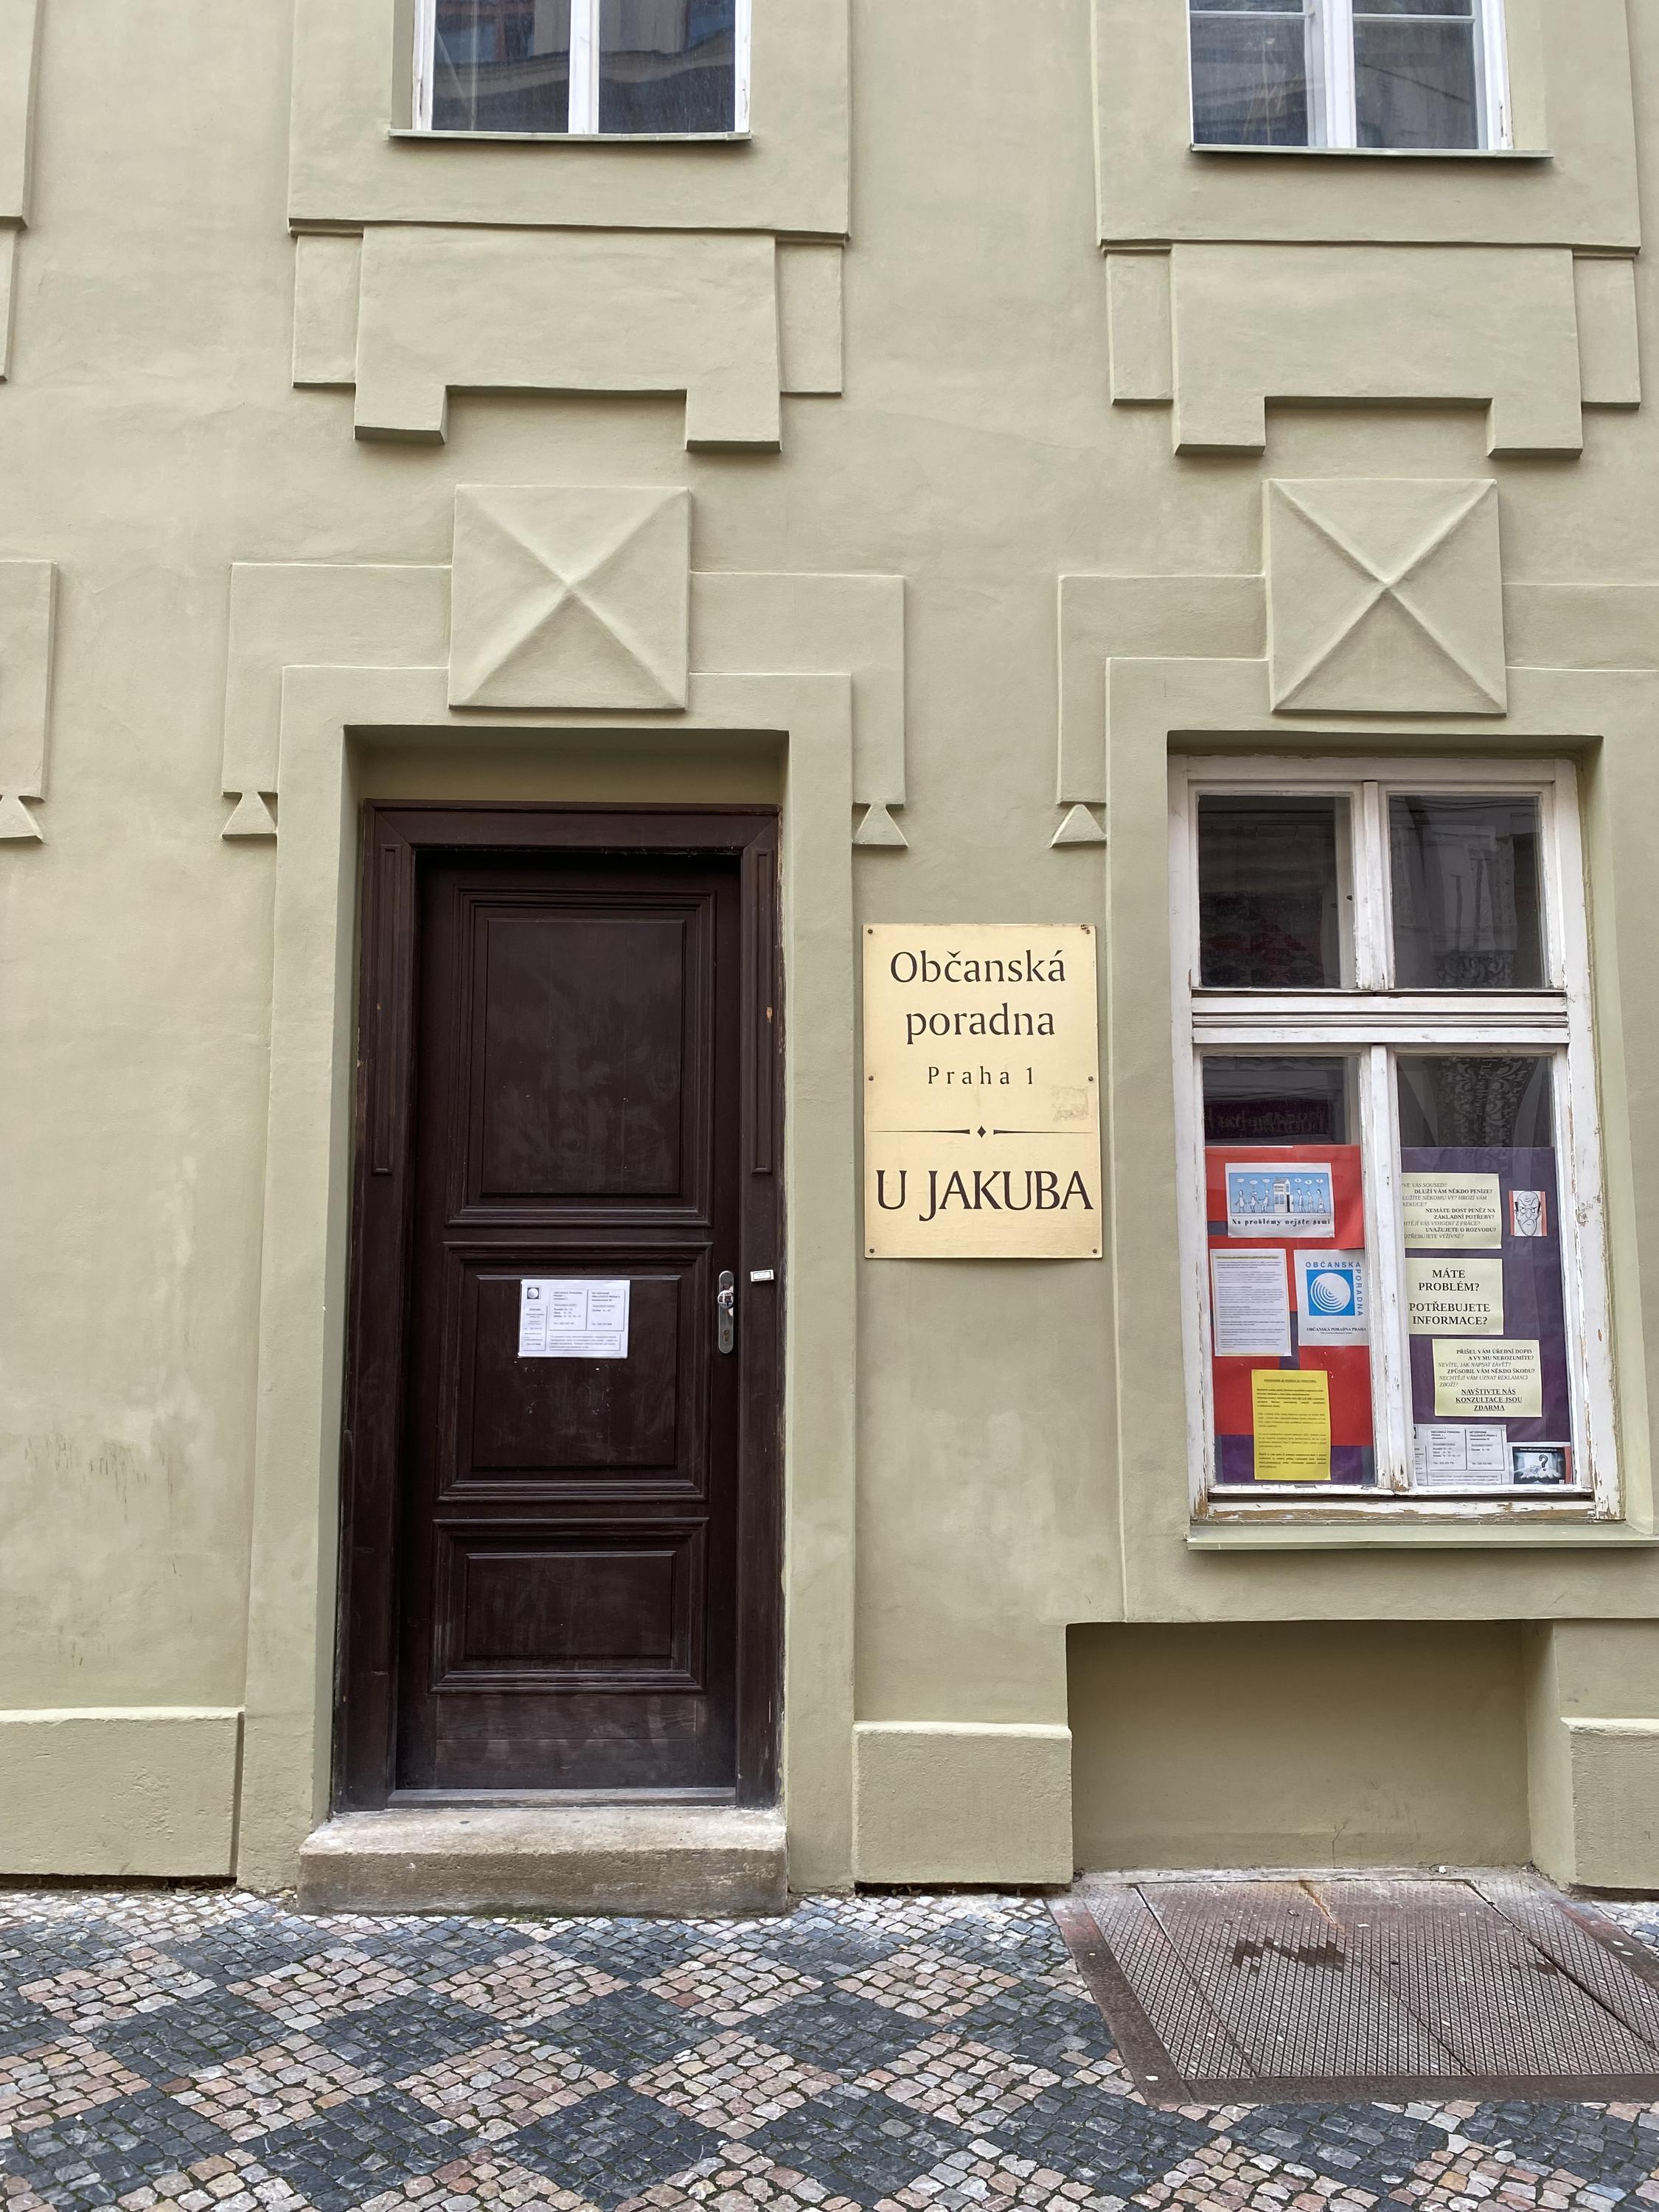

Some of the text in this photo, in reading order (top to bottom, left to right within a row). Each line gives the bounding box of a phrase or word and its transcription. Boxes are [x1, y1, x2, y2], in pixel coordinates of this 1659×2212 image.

[890, 950, 1065, 983] Občanská
[906, 1003, 1055, 1045] poradna
[928, 1066, 1033, 1085] Praha 1
[876, 1170, 1093, 1221] U JAKUBA
[1245, 1218, 1281, 1226] problémy
[1285, 1218, 1310, 1227] nejste
[1432, 1267, 1466, 1279] MÁTE
[1355, 1269, 1363, 1316] PORADNA
[1418, 1281, 1480, 1291] PROBLÉM?
[1409, 1301, 1490, 1312] POTŘEBUJETE
[1413, 1315, 1488, 1325] INFORMACE?
